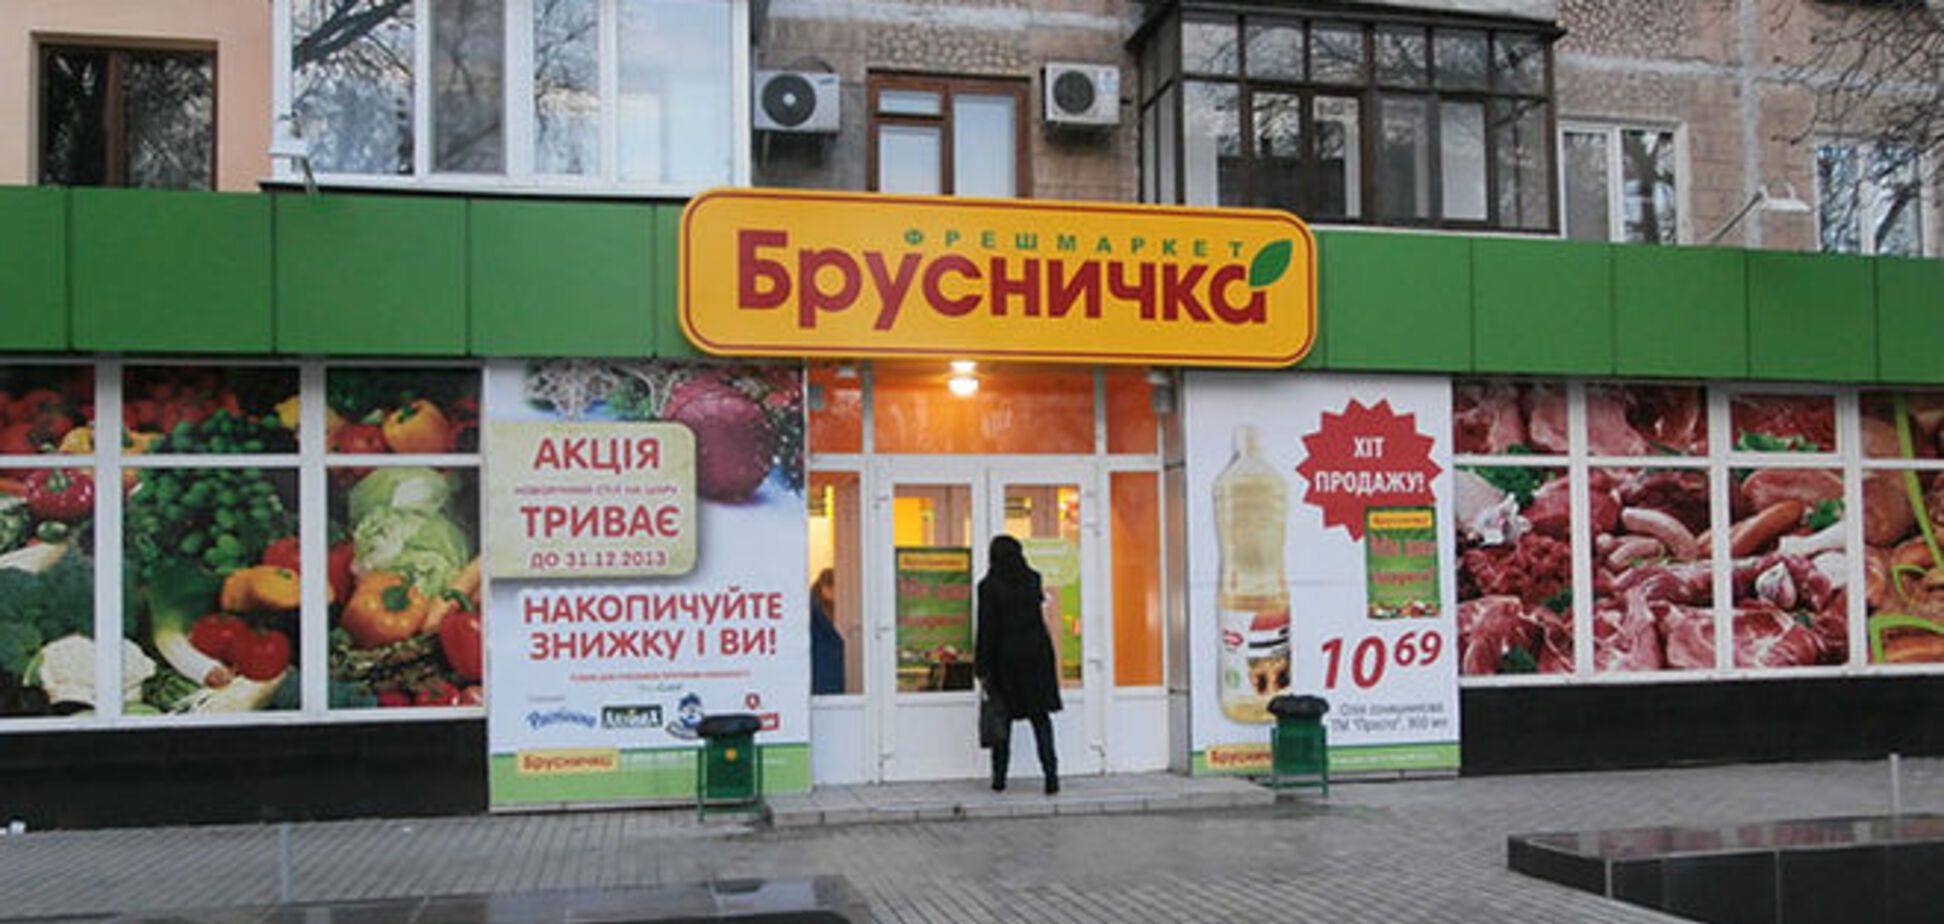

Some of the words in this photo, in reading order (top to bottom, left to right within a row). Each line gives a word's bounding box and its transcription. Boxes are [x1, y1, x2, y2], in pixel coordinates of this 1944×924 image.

[903, 229, 1245, 259] ФРЕШМАРКЕТ
[737, 228, 1267, 331] Брусничка
[533, 437, 661, 475] АКЦІЯ
[1354, 437, 1385, 458] ХІТ
[1315, 471, 1425, 497] ПРОДАЖУ!
[520, 505, 680, 539] ТРИВАЄ
[530, 552, 560, 569] ДО
[567, 551, 667, 567] 31.12.2013
[523, 586, 783, 625] НАКОПИЧУЙТЕ
[529, 628, 685, 661] ЗНИЖКУ
[696, 631, 705, 655] І
[720, 627, 777, 656] ВИ!
